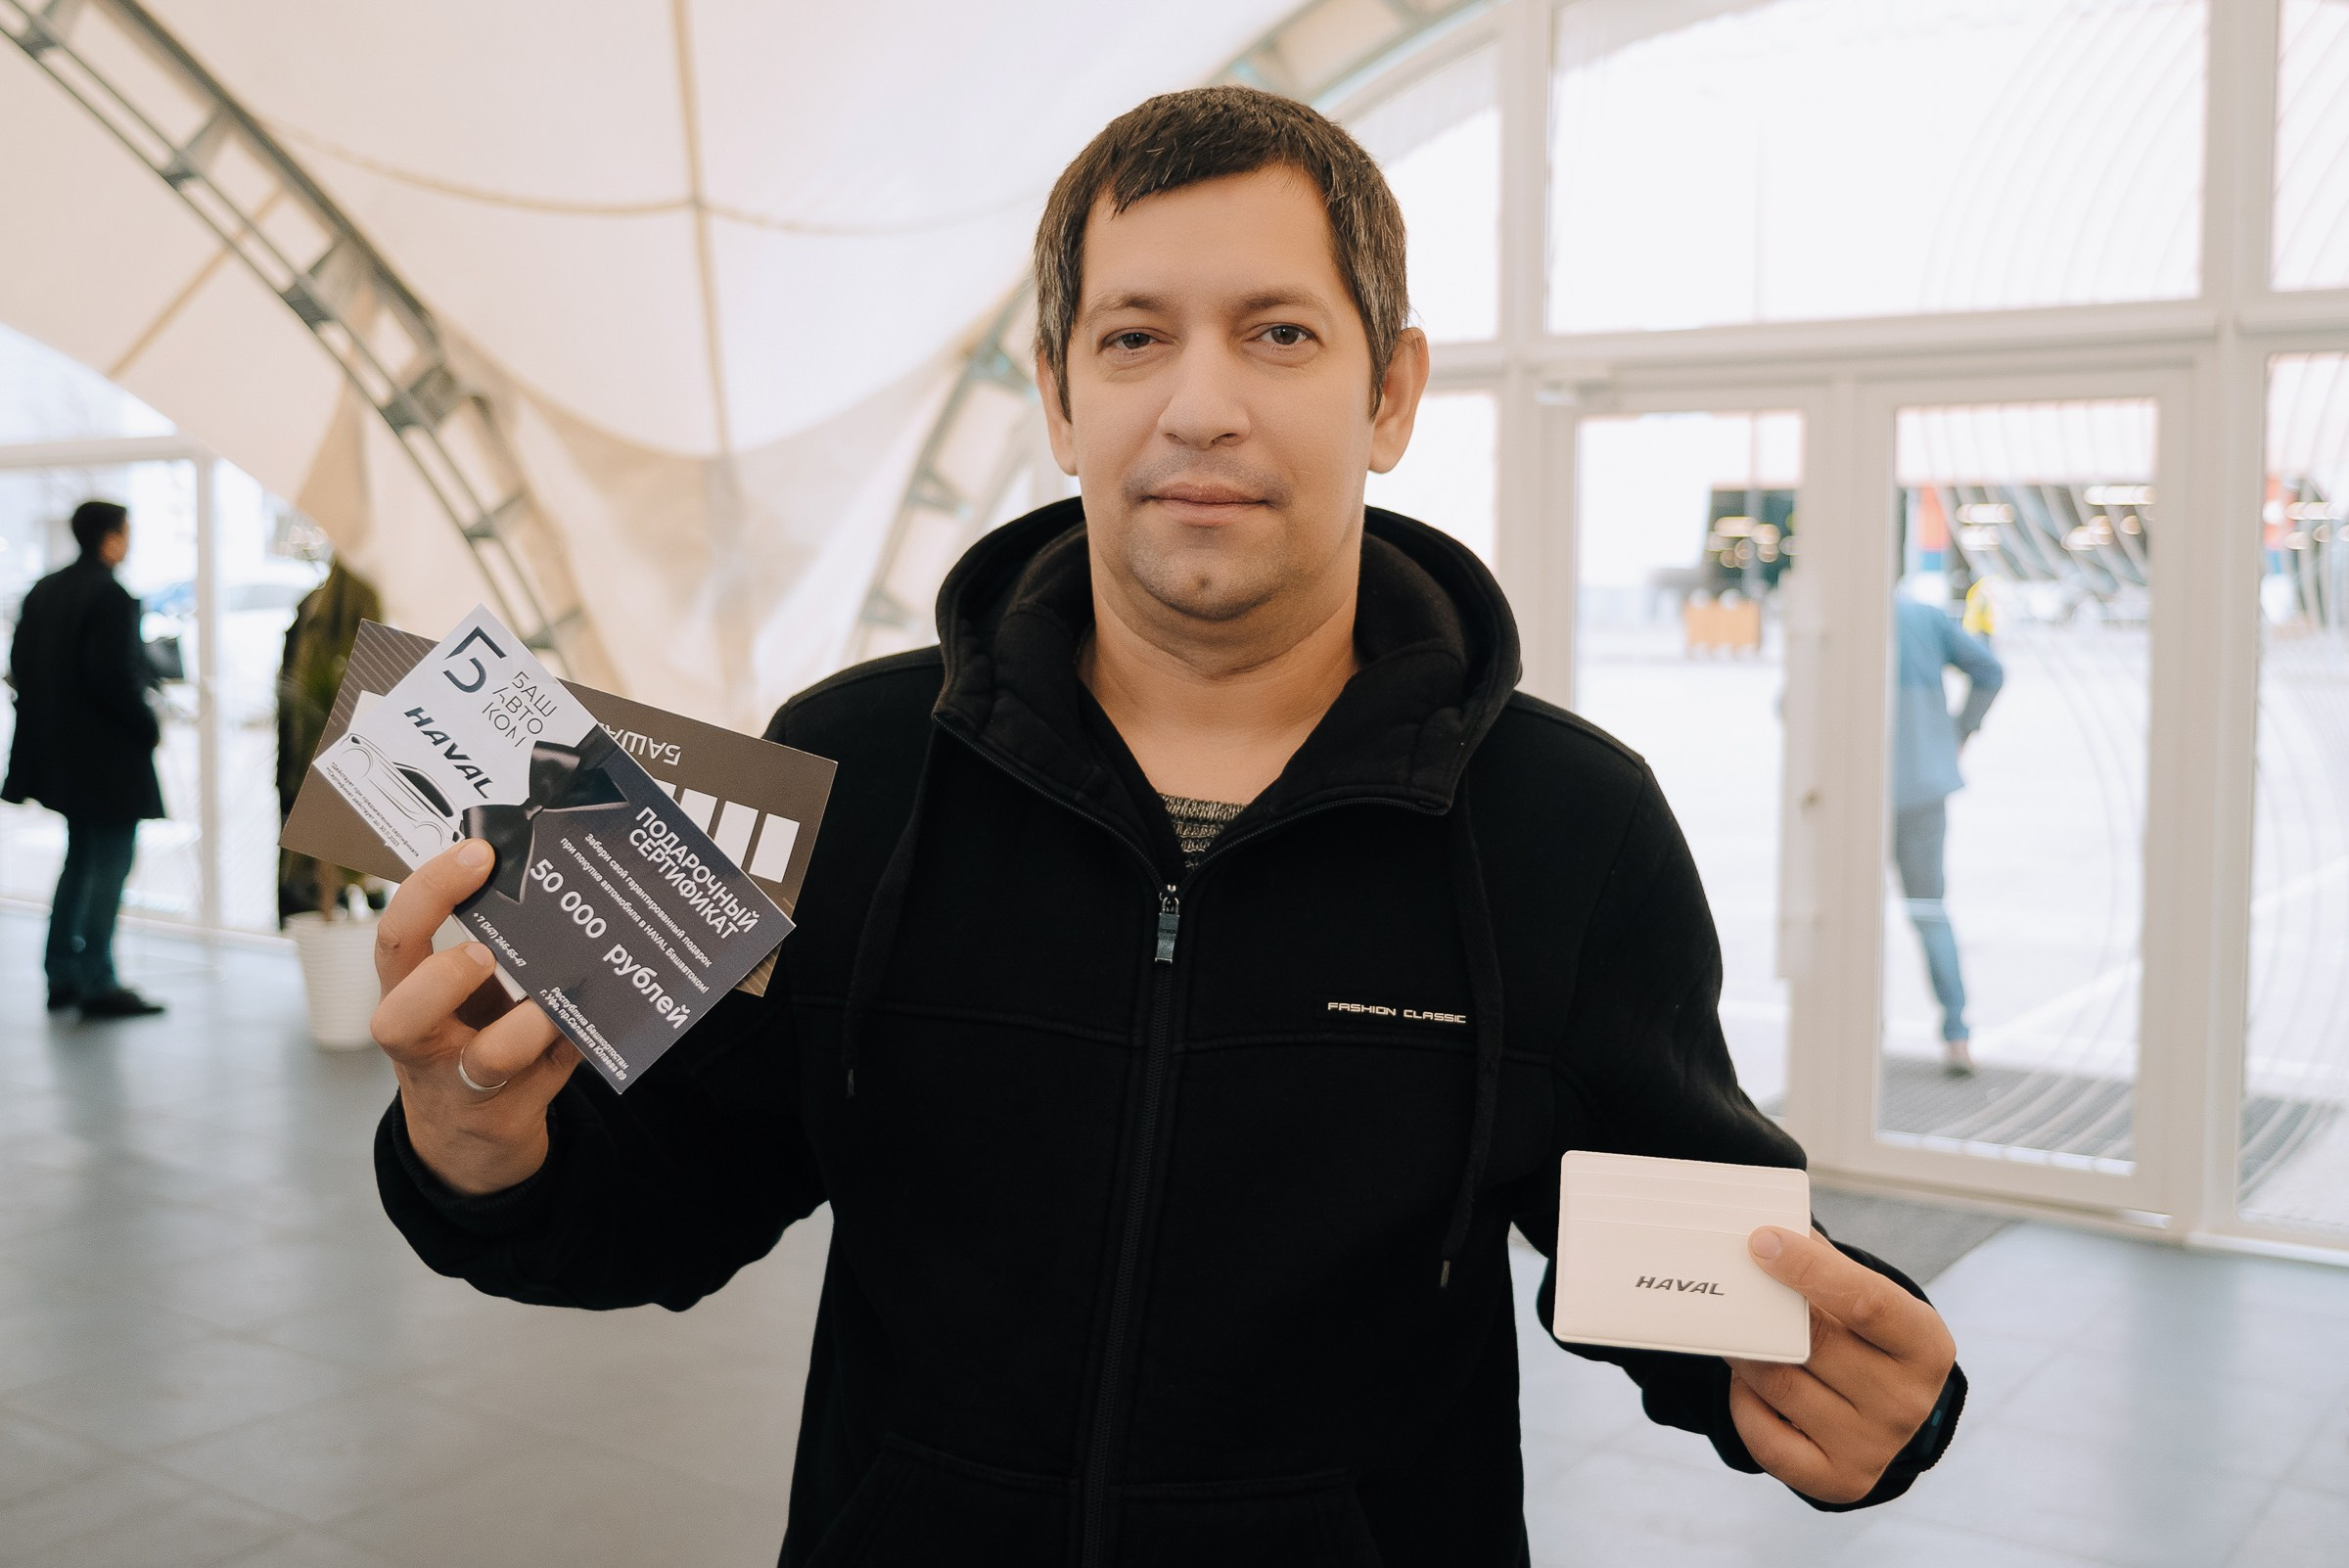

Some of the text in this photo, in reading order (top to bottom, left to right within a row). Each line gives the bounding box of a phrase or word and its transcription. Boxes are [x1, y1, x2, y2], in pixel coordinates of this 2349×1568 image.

[482, 702, 527, 748] КОМ
[492, 686, 543, 735] АВТО
[512, 670, 558, 717] БАШ
[403, 706, 493, 799] HAVAL
[598, 722, 681, 765] БАША
[351, 797, 375, 820] действует
[373, 818, 382, 827] до
[352, 785, 363, 798] при
[392, 828, 420, 857] сертификата
[584, 833, 713, 968] Забери свой гарантированный подарок
[628, 828, 739, 940] СЕРТИФИКАТ
[635, 806, 760, 934] ПОДАРОЧНЫЙ
[480, 921, 499, 940] (347)
[494, 936, 528, 967] 246-65-47
[530, 858, 691, 1029] 50 000 рублей
[560, 837, 711, 994] при покупке автомобиля в HAVAL Башавтоком!
[544, 992, 560, 1012] Уфа,
[593, 1044, 619, 1073] Юлаева
[616, 1069, 627, 1081] 89
[551, 987, 629, 1071] Республика Башкортостан
[1327, 1001, 1466, 1024] FASHION CLASSIC
[1635, 1275, 1725, 1296] HAVAL
